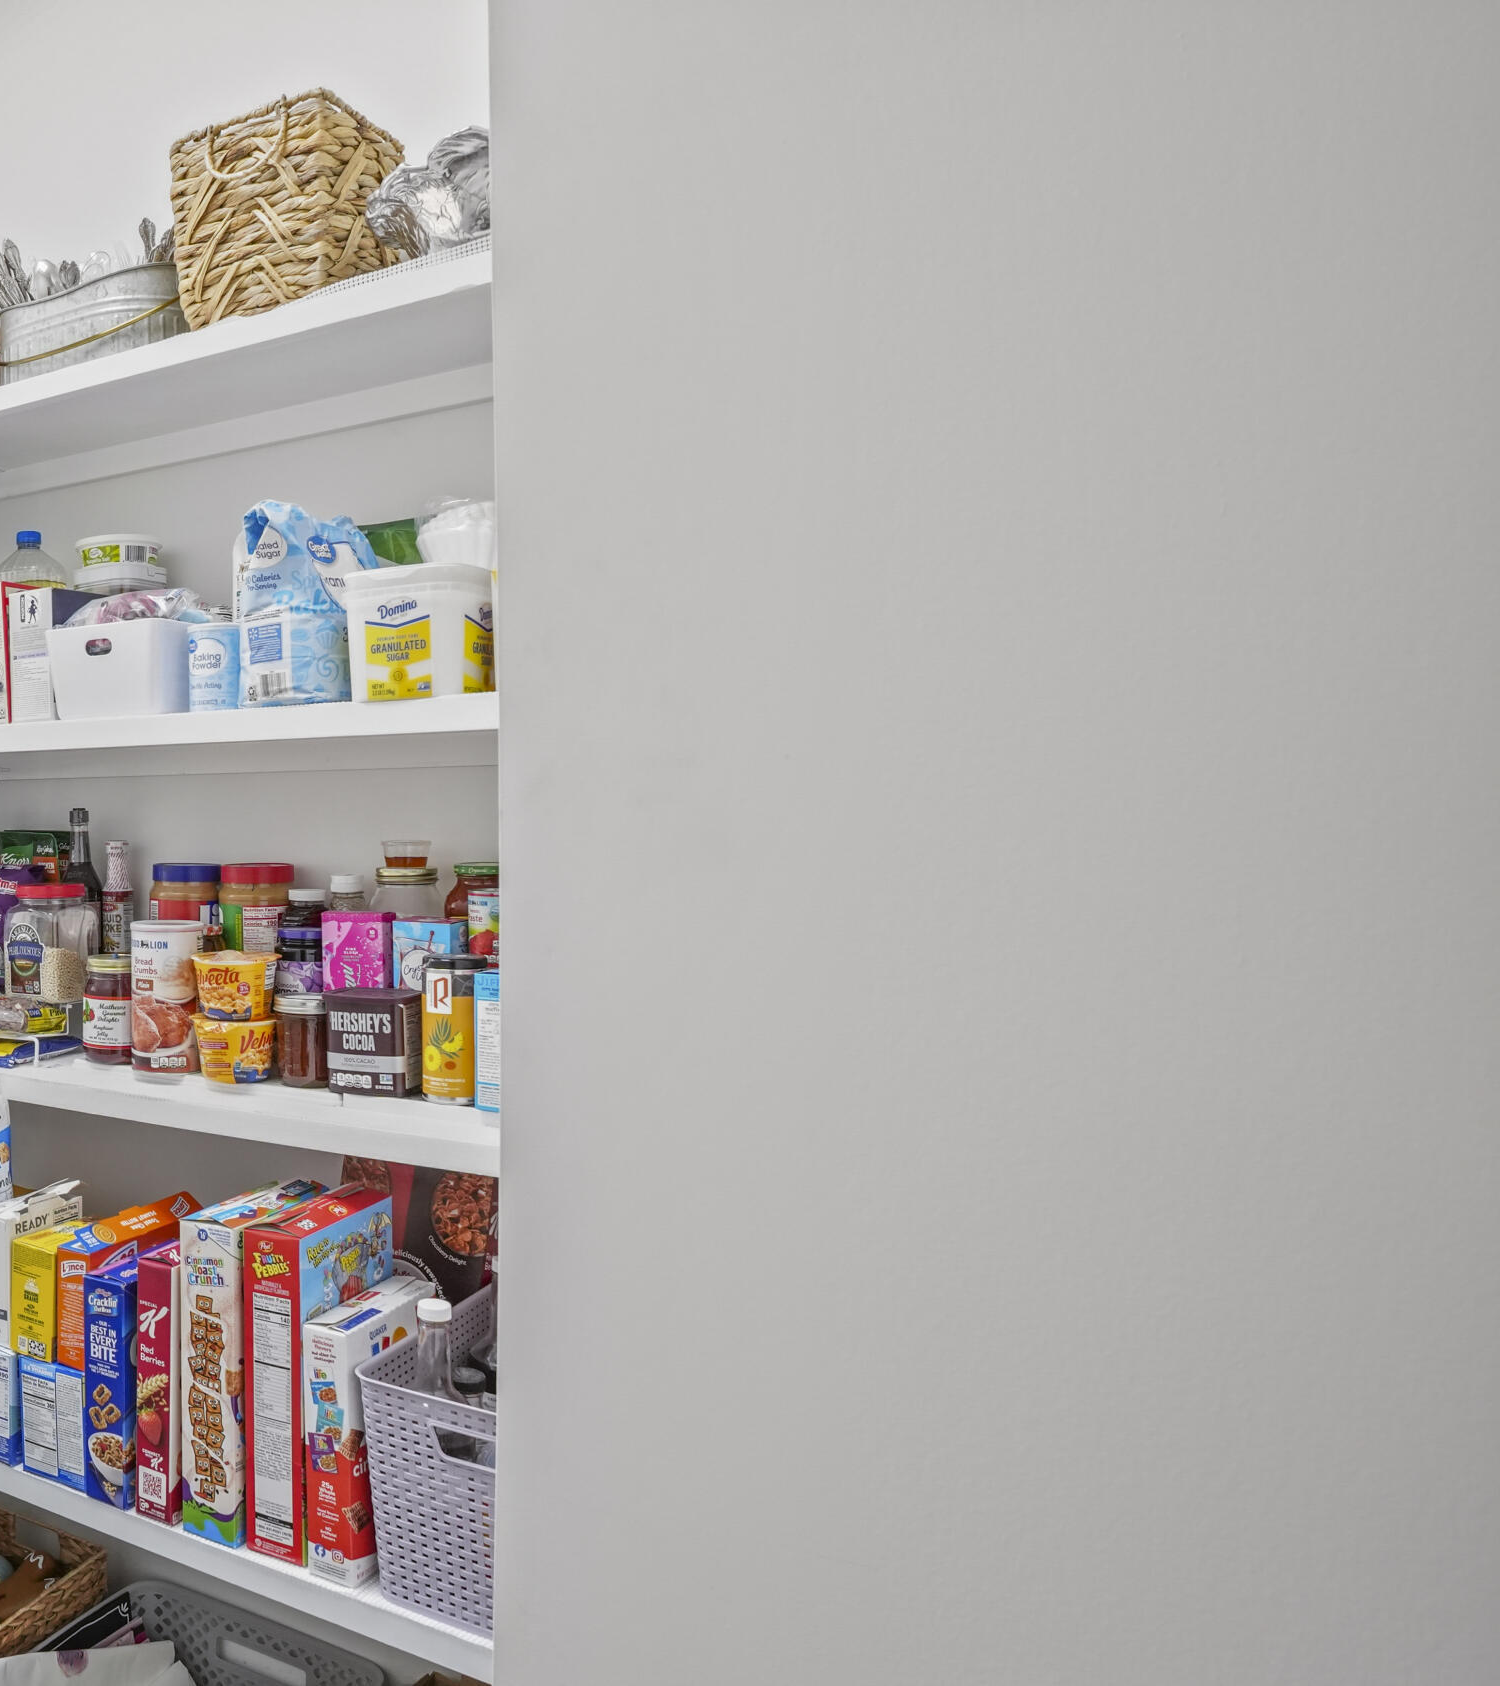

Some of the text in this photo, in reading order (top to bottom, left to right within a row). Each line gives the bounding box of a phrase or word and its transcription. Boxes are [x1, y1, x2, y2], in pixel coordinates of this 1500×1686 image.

[256, 550, 281, 559] Sugar
[251, 573, 282, 583] Calories
[255, 582, 278, 590] Serving
[377, 600, 418, 619] Domino
[370, 640, 426, 654] GRANULATED
[192, 652, 222, 665] Baking
[386, 652, 410, 662] SUGAR
[191, 661, 222, 671] Powder
[0, 853, 30, 865] Knorr
[103, 924, 122, 933] OKE
[150, 941, 169, 949] LION
[134, 957, 153, 966] Bread
[133, 965, 158, 975] Crumbs
[330, 1011, 392, 1034] HERSHEY'S
[342, 1033, 375, 1052] COCOA
[15, 1214, 48, 1235] READY
[185, 1256, 223, 1266] Cinnamon
[252, 1252, 284, 1264] FRUITY
[448, 1253, 467, 1267] Delight
[191, 1264, 217, 1275] Toast
[252, 1262, 290, 1279] PEBBLES
[188, 1273, 224, 1286] Crunch
[88, 1295, 118, 1308] Cracklin'
[140, 1300, 158, 1308] SPECIAL
[254, 1294, 275, 1302] Nutrition
[140, 1306, 170, 1339] K
[90, 1324, 117, 1338] BEST IN
[369, 1323, 388, 1341] QUAKER
[90, 1334, 117, 1349] EVERY
[90, 1344, 117, 1364] BITE
[140, 1343, 154, 1355] Red
[140, 1352, 165, 1367] Berries
[313, 1368, 327, 1380] life
[321, 1480, 334, 1491] 25g
